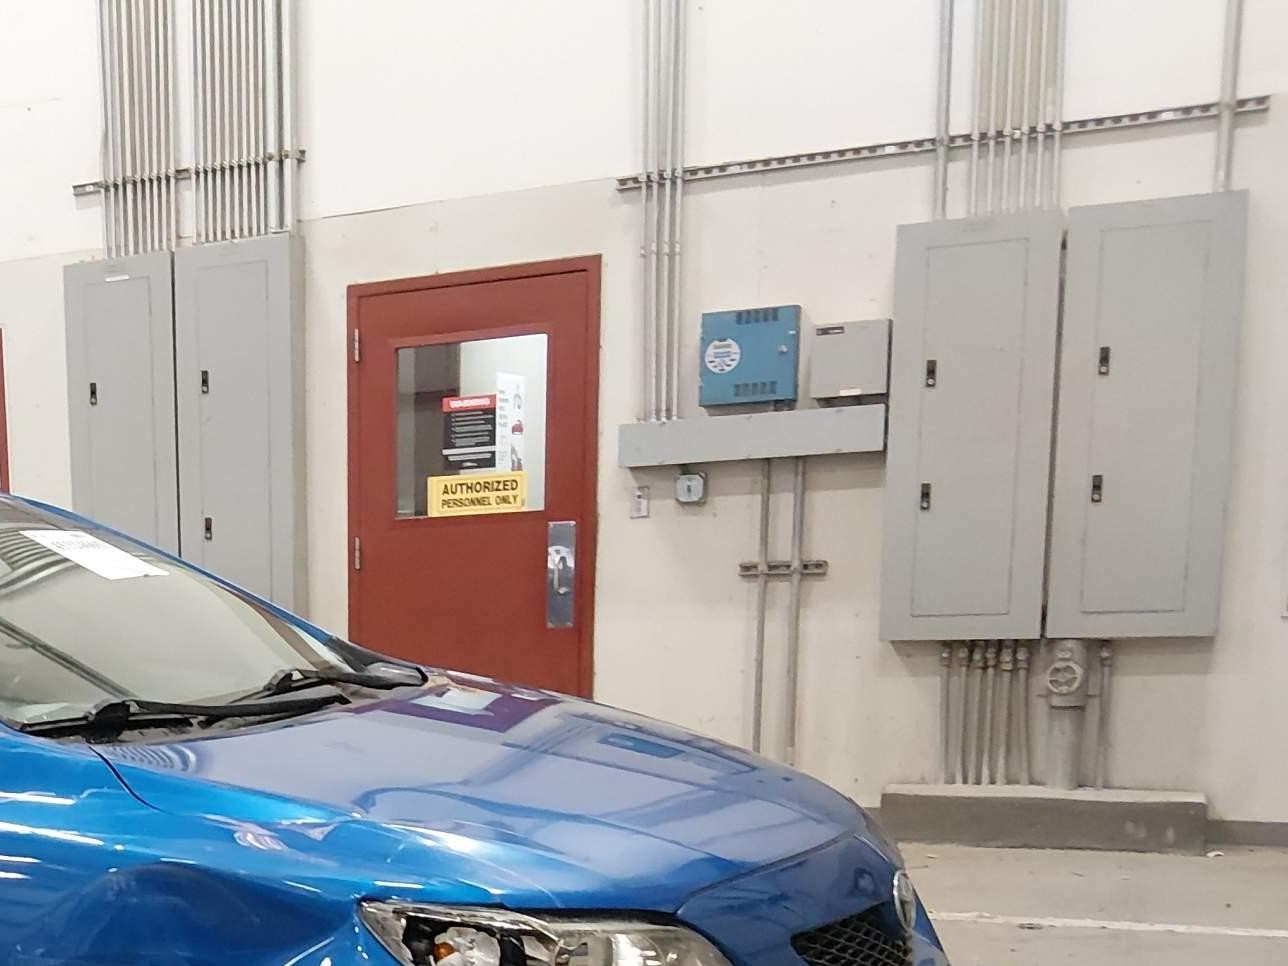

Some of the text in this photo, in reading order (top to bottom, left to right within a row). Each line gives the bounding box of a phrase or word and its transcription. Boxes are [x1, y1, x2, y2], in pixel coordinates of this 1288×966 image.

[442, 479, 518, 495] AUTHORIZED
[441, 495, 519, 508] PERSONNEL ONLY
